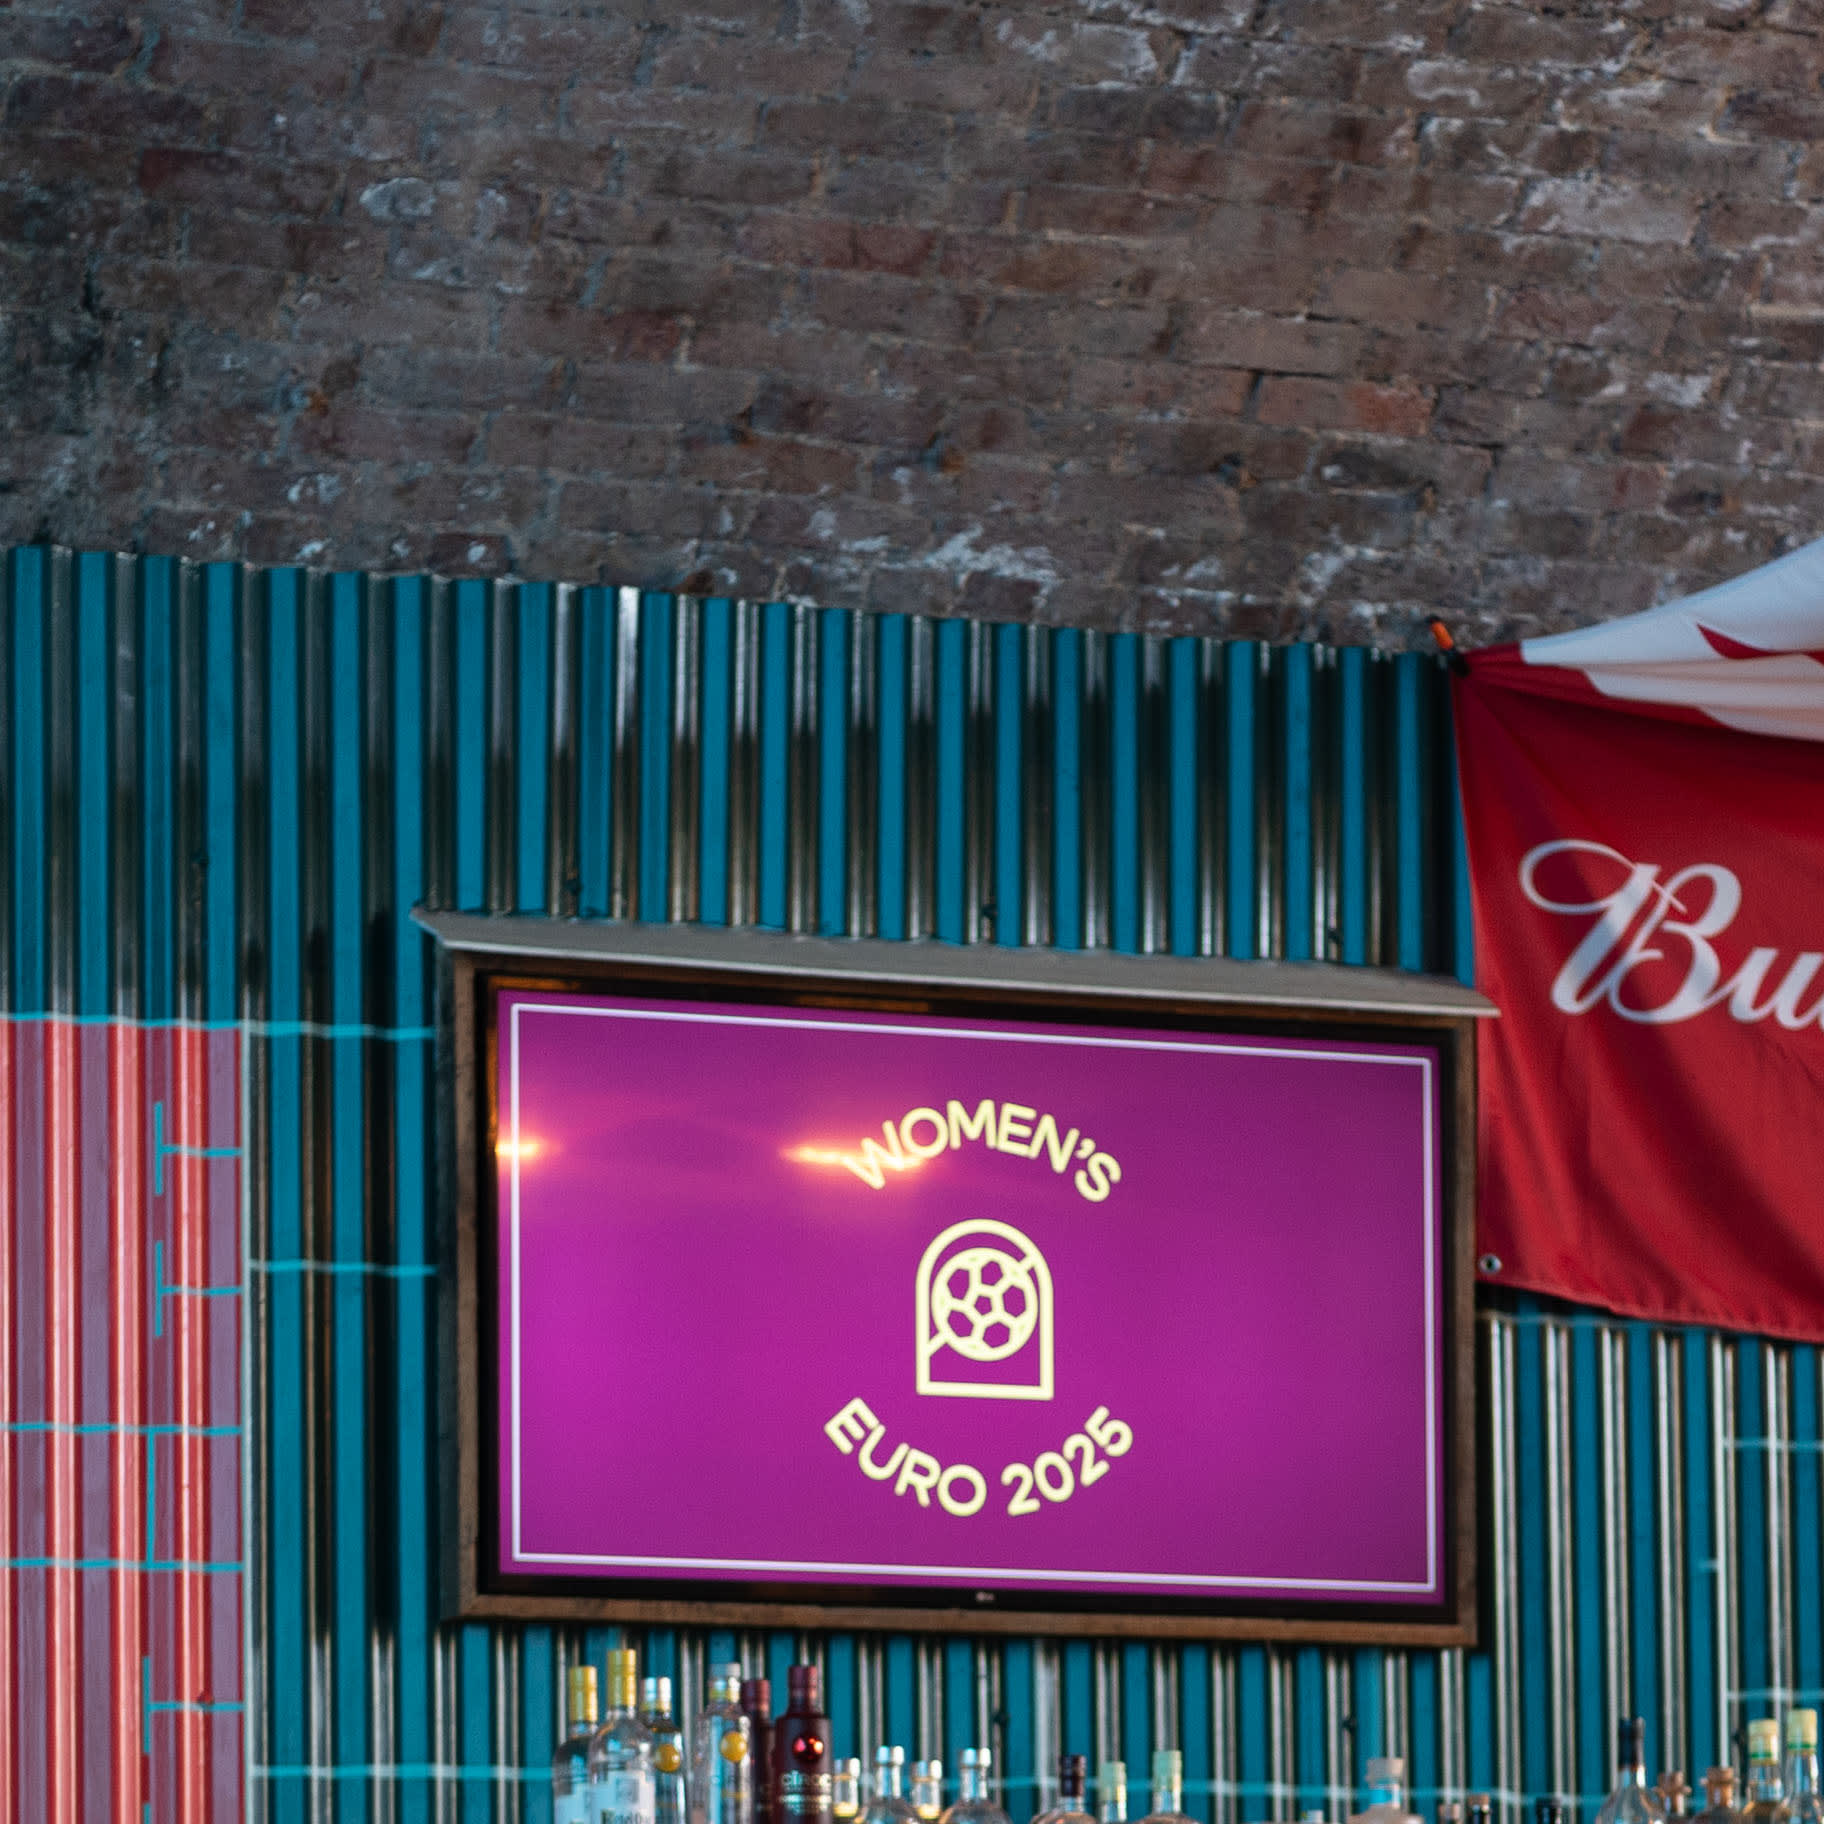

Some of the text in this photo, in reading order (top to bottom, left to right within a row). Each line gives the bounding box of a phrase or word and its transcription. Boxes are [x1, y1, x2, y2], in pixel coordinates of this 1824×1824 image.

[843, 1099, 1122, 1202] WOMEN'S
[823, 1397, 1134, 1517] EURO 2025
